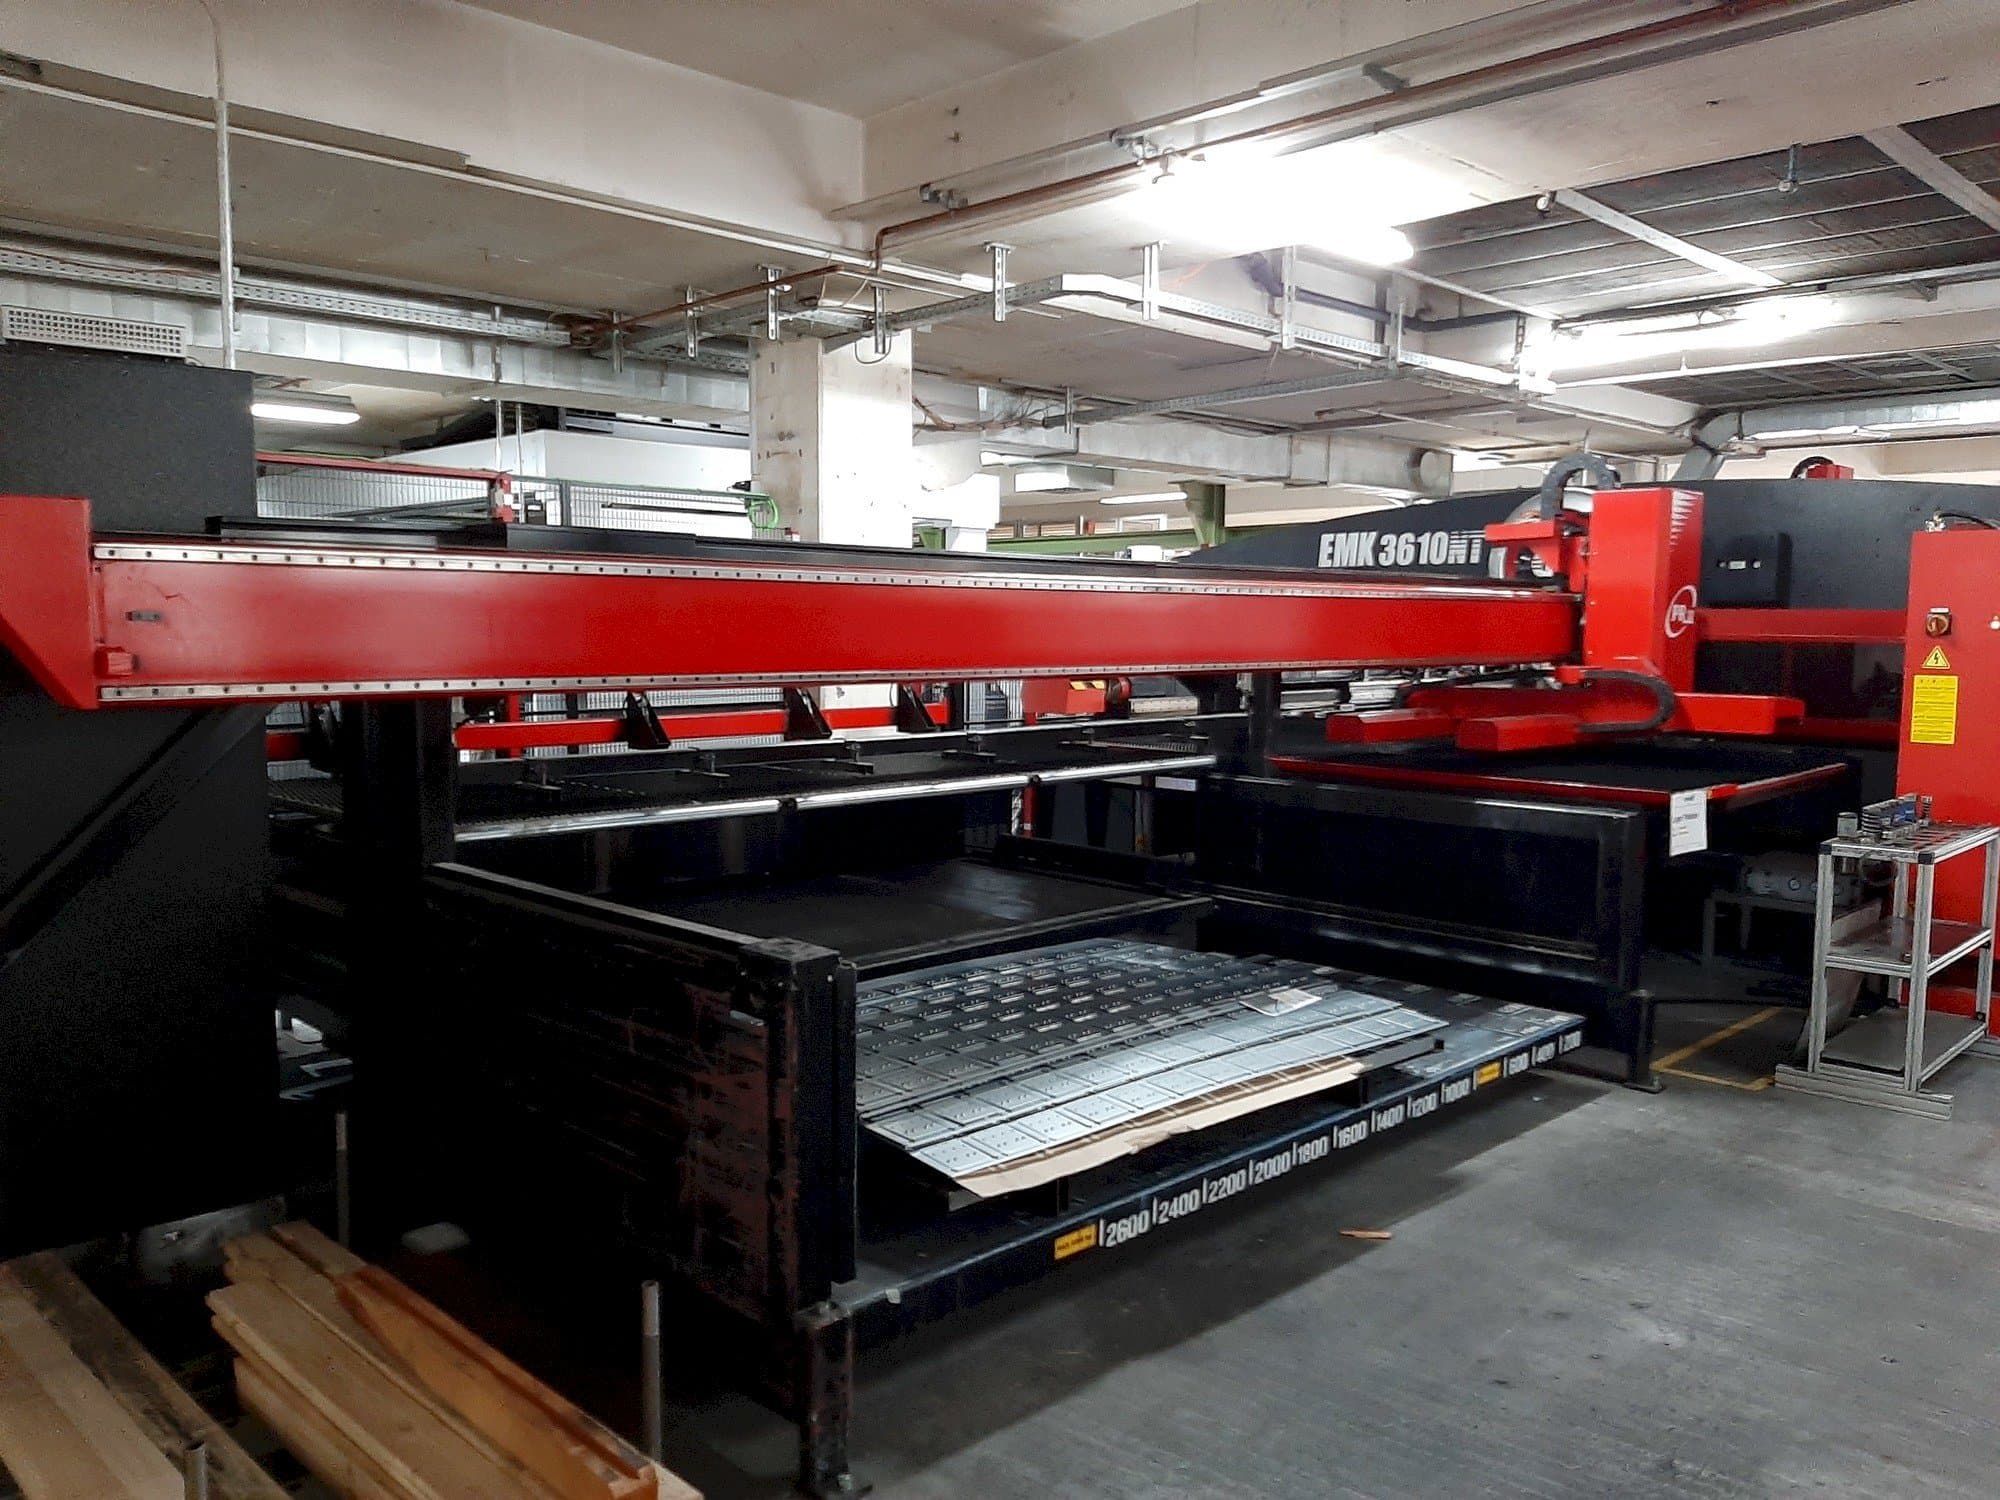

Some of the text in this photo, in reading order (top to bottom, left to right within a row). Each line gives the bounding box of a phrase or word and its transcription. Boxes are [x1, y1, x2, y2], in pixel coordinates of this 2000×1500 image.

[1318, 531, 1377, 568] EMK
[1105, 1210, 1149, 1248] 2600
[1158, 1188, 1201, 1225] 2400
[1207, 1169, 1247, 1204] 2200
[1254, 1151, 1291, 1185] 2000
[1297, 1136, 1329, 1165] 1800
[1338, 1119, 1368, 1149] 1600
[1376, 1103, 1404, 1132] 1400
[1411, 1092, 1438, 1118] 1200
[1444, 1077, 1471, 1104] 1000
